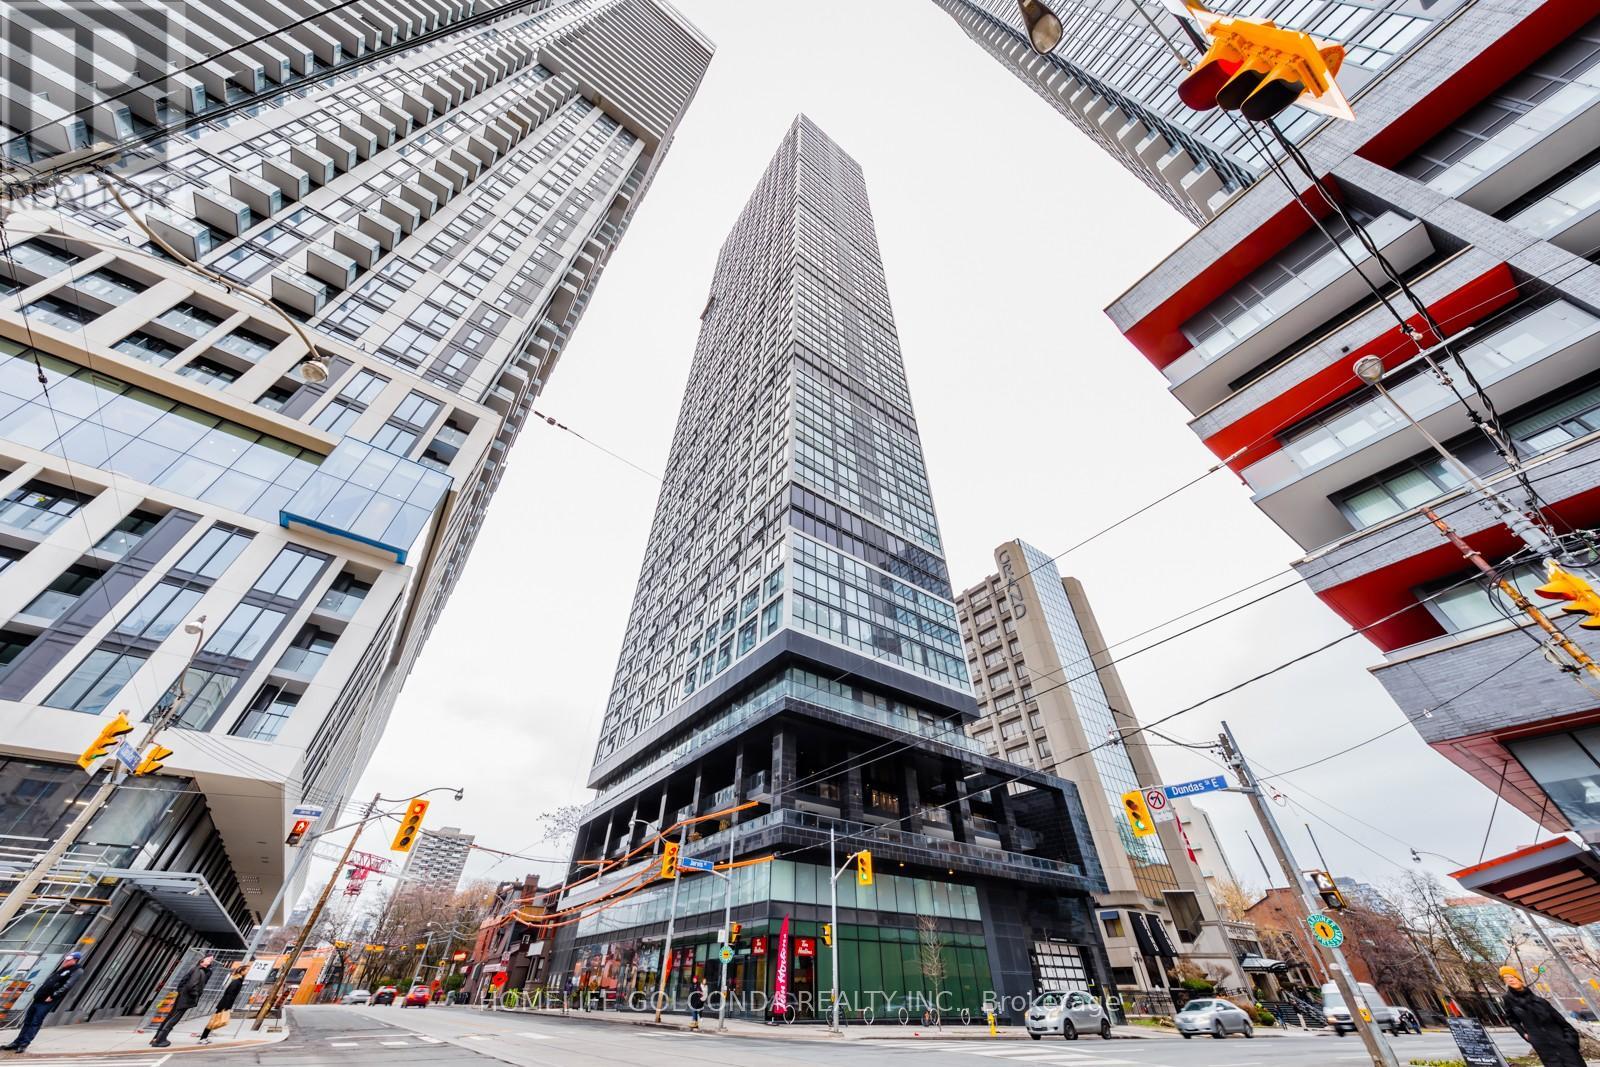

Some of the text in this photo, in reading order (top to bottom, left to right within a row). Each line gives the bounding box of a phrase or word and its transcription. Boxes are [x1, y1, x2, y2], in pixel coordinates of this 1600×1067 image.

[999, 550, 1026, 620] GRAND
[1172, 783, 1205, 796] Dundas
[1210, 778, 1220, 788] E
